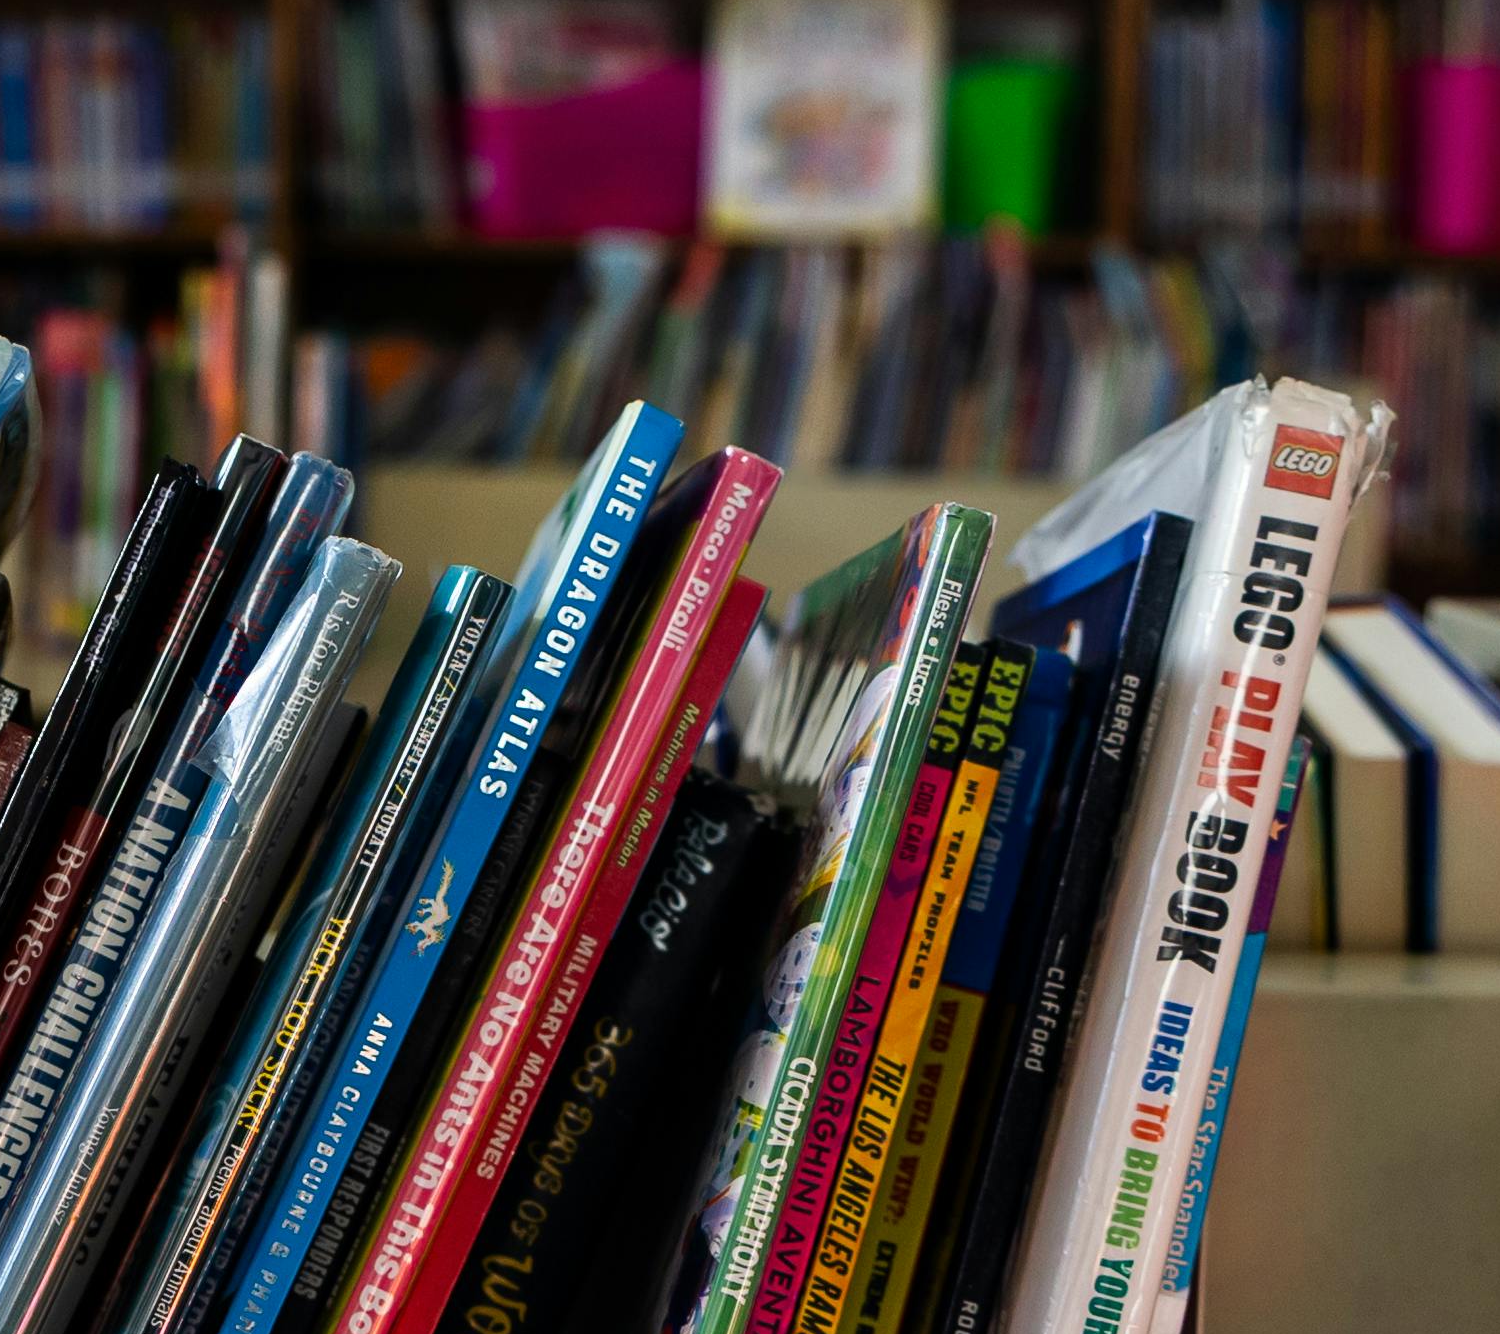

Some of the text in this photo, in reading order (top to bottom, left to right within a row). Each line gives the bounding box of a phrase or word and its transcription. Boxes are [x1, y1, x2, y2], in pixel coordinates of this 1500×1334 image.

[1275, 444, 1334, 478] LEGO
[657, 480, 753, 655] Mosco Pirolli
[262, 587, 359, 757] R is for Rhyme
[475, 450, 655, 801] THE DRAGON ATLAS
[901, 577, 963, 709] Fliess Lucas
[926, 657, 981, 756] EPIC
[966, 654, 1025, 755] EPIC
[1193, 666, 1283, 805] PLAY
[144, 776, 192, 815] A
[76, 813, 174, 962] NATION
[533, 790, 615, 916] There
[903, 777, 981, 991] NFL TEAM PROFILES
[1152, 805, 1250, 978] BOOK
[500, 910, 561, 990] Are
[234, 911, 353, 1135] YUCK, YOU SUCK!
[472, 988, 524, 1051] No
[473, 932, 599, 1182] MILITARY MACHINES
[1138, 999, 1194, 1098] IDEAS
[427, 1050, 496, 1153] Ants
[847, 1105, 893, 1160] LOS
[863, 1054, 909, 1107] THE
[1126, 1097, 1171, 1145] TO
[409, 1149, 453, 1195] in
[714, 1053, 821, 1305] CICADA SYMPHONY
[812, 1159, 877, 1278] ANGELES
[1101, 1144, 1160, 1253] BRING
[368, 1193, 433, 1287] This
